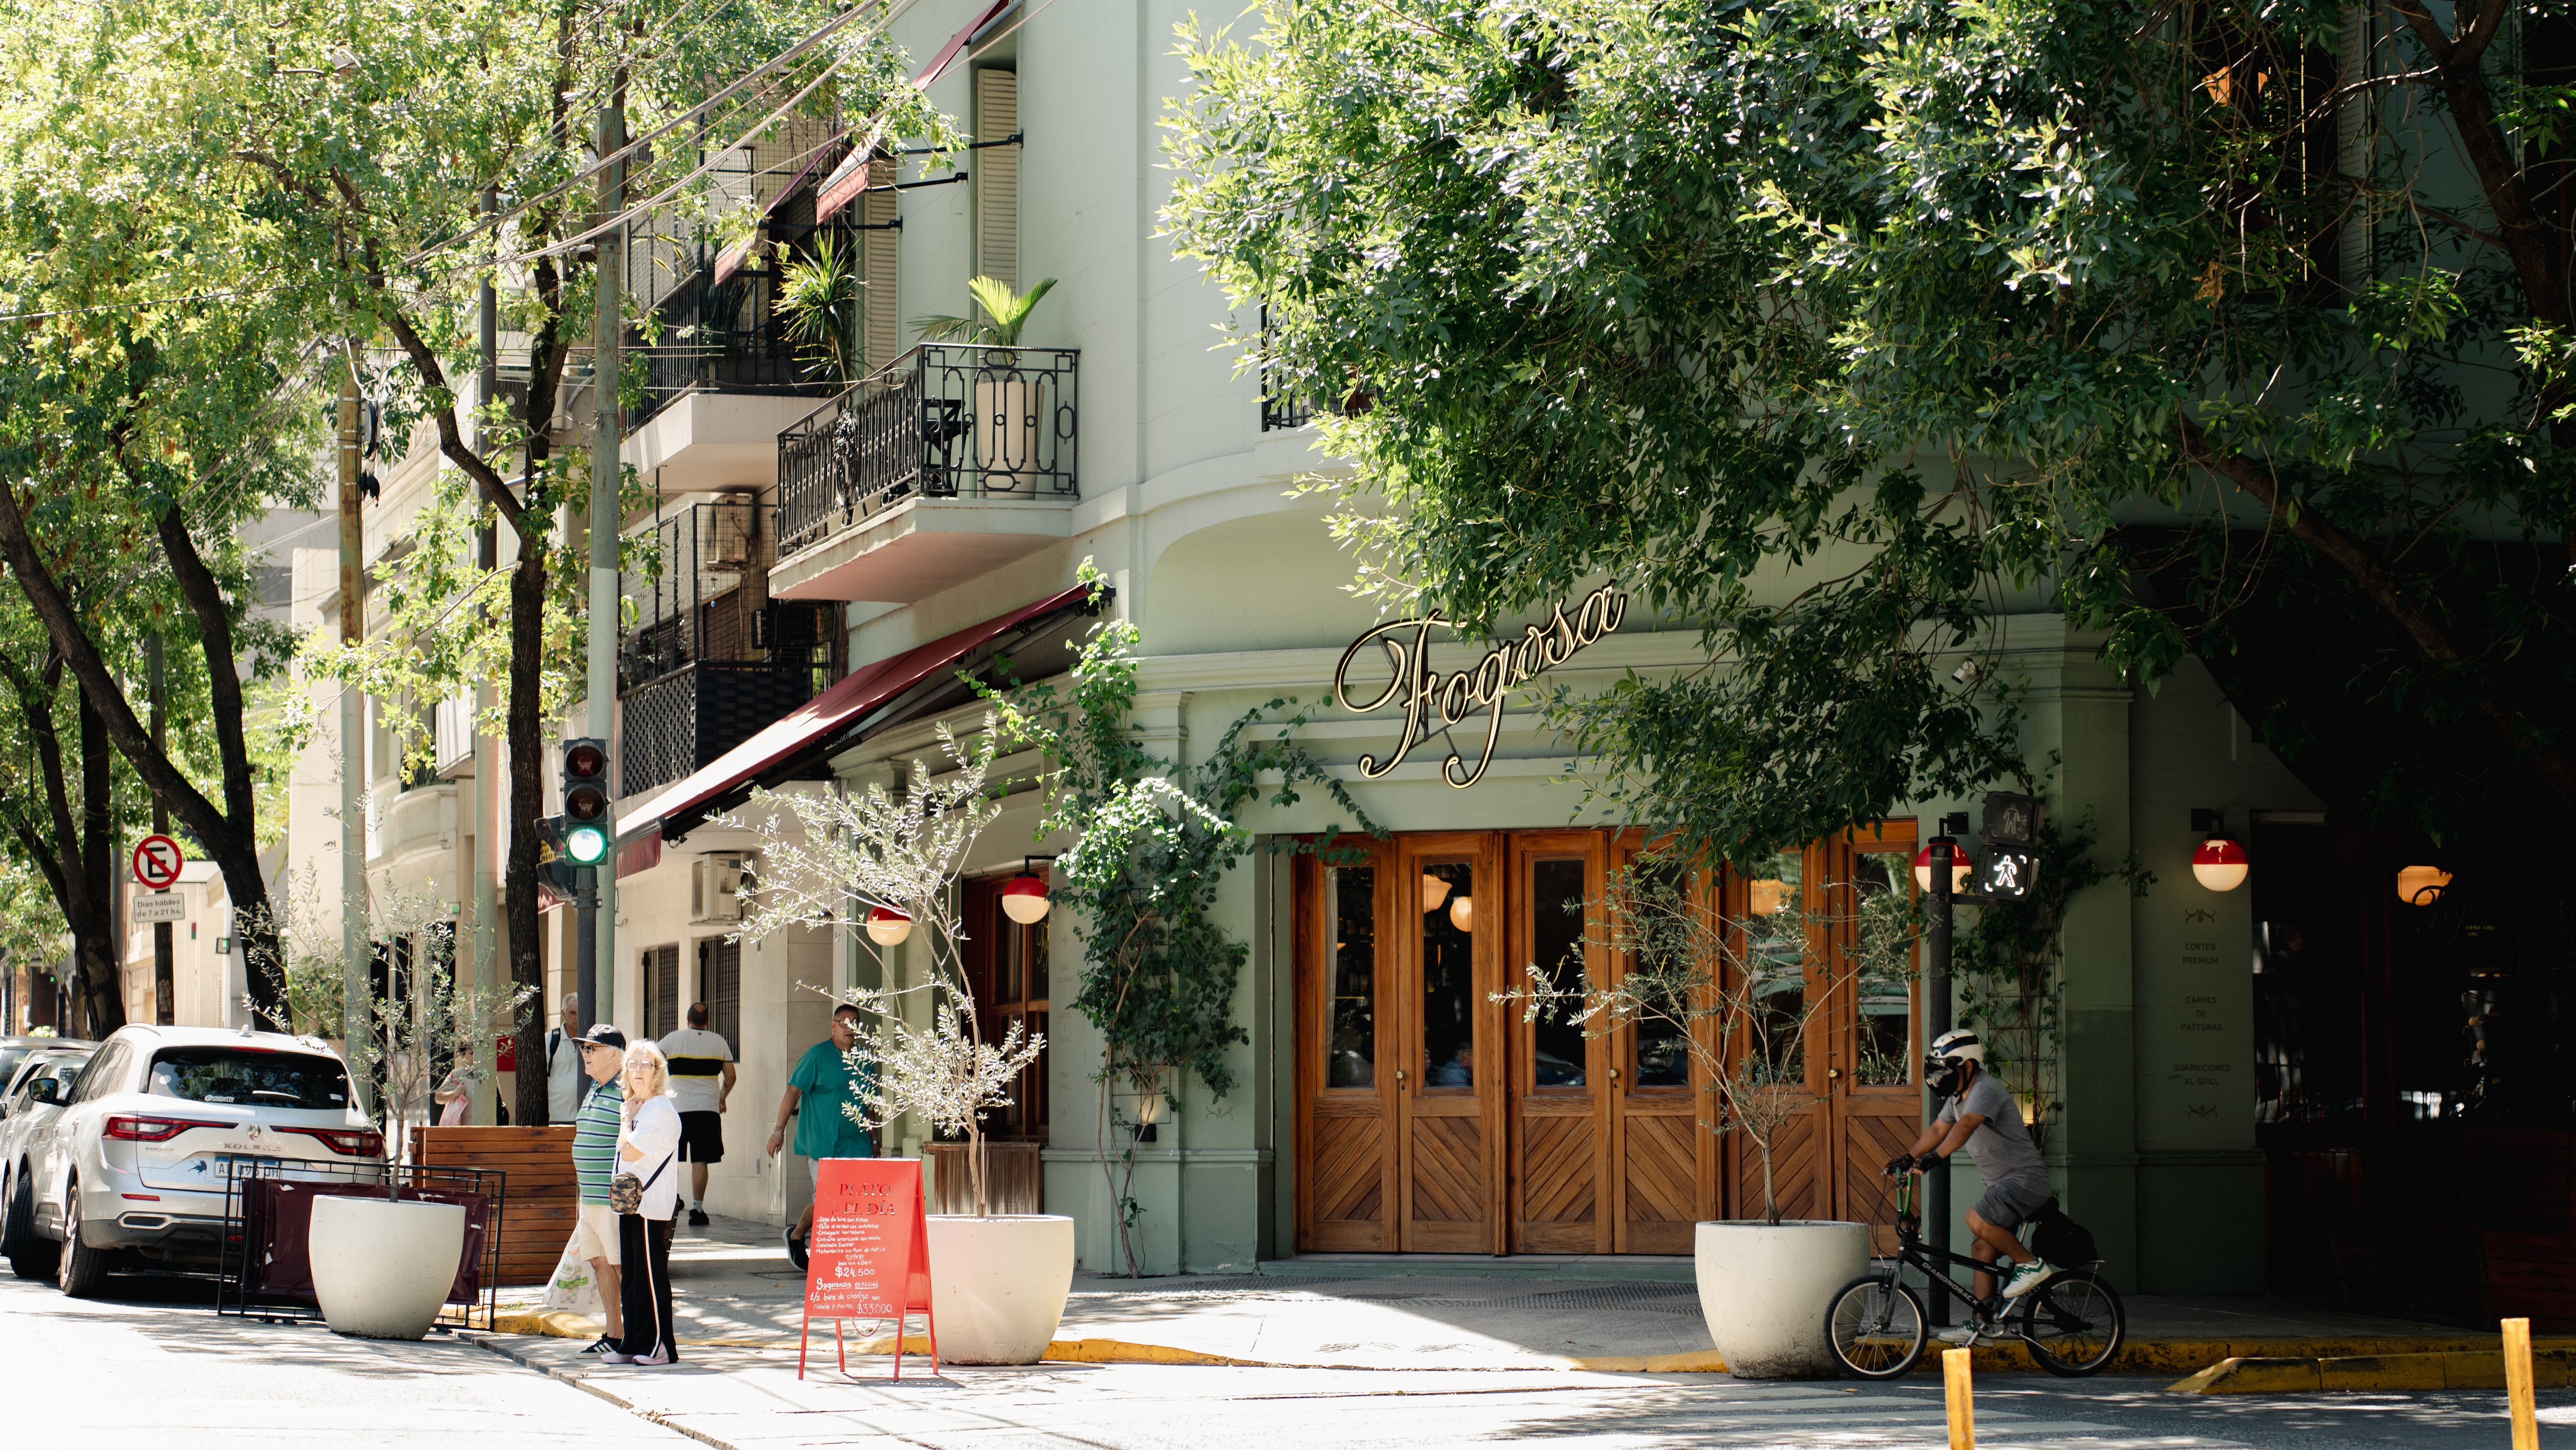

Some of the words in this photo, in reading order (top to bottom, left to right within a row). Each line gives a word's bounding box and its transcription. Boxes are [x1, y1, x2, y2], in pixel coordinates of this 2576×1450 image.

[1335, 579, 1627, 789] Fogosa
[137, 909, 146, 917] de
[225, 1143, 281, 1151] KOLEOS
[840, 1183, 891, 1196] PLATO
[831, 1202, 863, 1215] DEL
[867, 1200, 895, 1216] DÍA
[835, 1266, 875, 1278] $24.500
[816, 1277, 852, 1292] Sugerencia
[1922, 1262, 1980, 1306] DIAMONDBACK
[809, 1291, 820, 1303] 1/2
[847, 1291, 869, 1302] chorizo
[857, 1302, 892, 1315] $33.000
